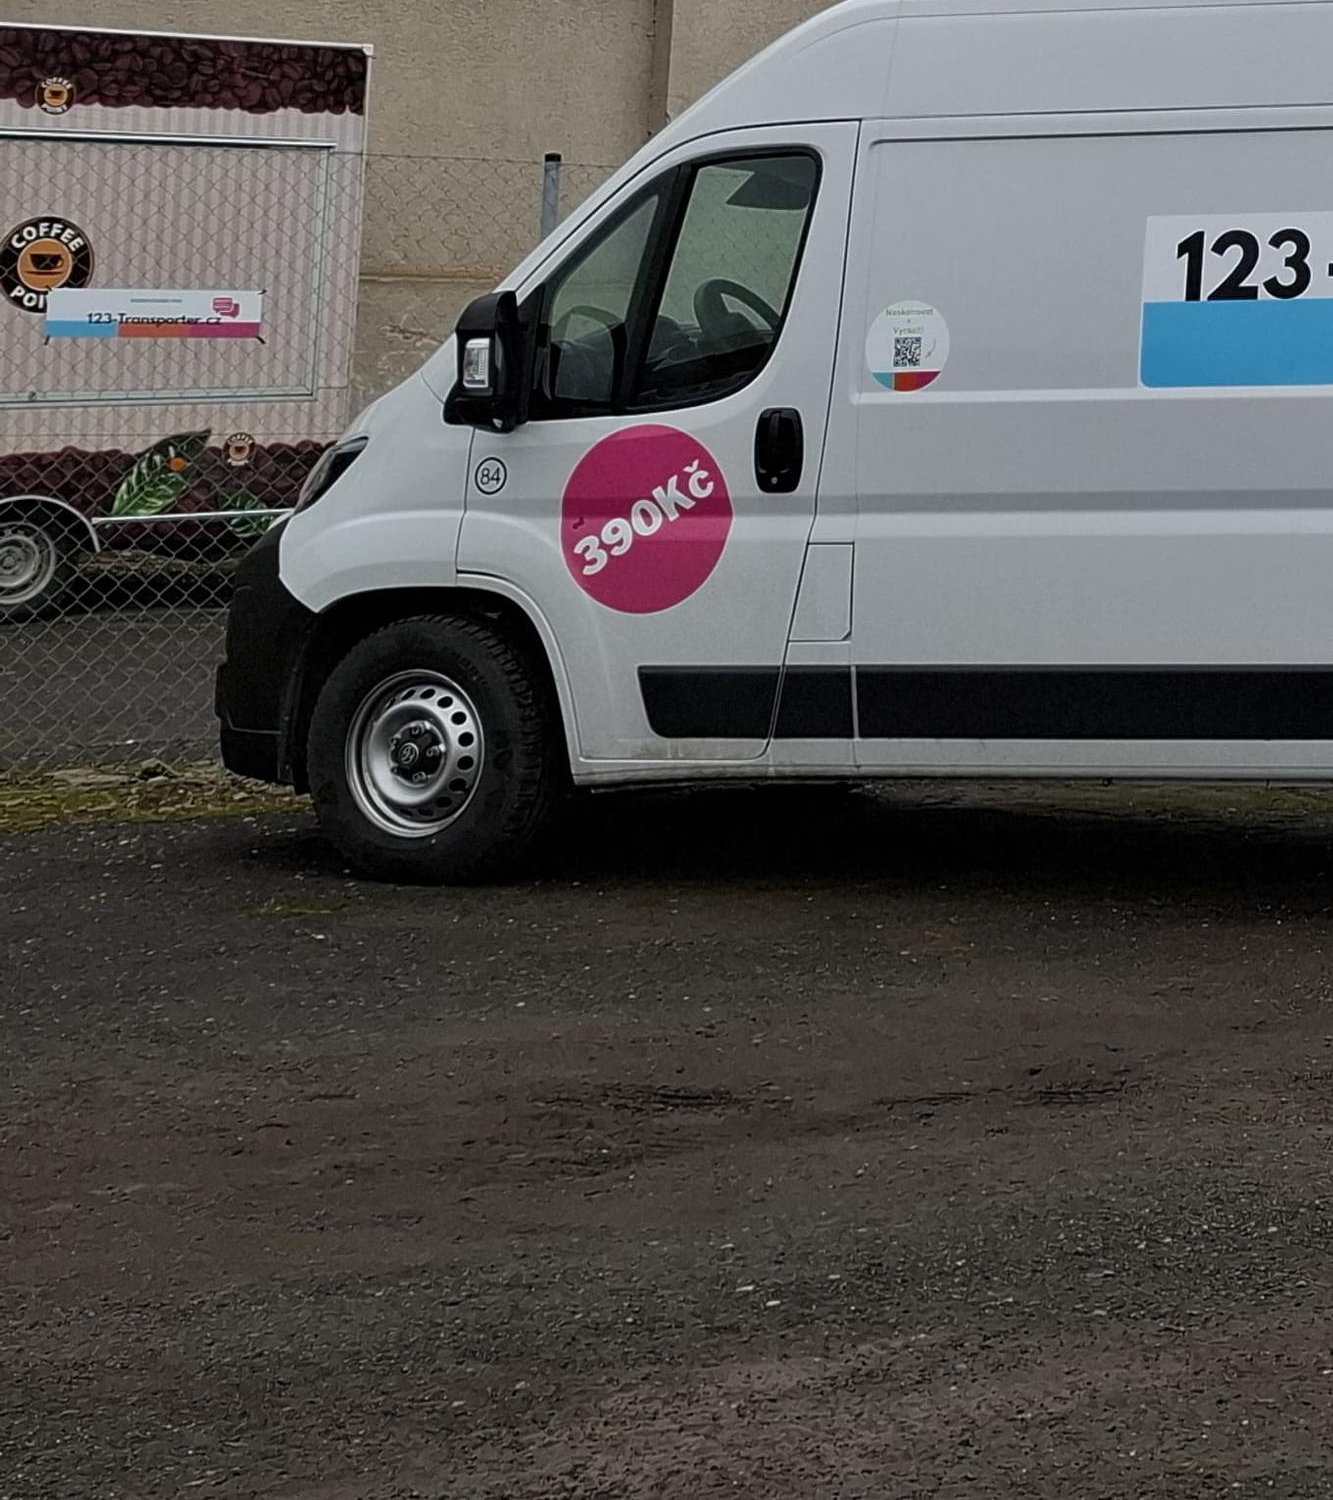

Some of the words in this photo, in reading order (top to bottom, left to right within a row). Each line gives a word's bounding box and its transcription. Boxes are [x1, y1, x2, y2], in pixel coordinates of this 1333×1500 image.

[11, 222, 84, 252] COFFEE
[10, 285, 45, 309] POI
[86, 313, 222, 328] 123-Transporter.cz
[480, 467, 501, 486] 84
[573, 459, 715, 576] 390Kč
